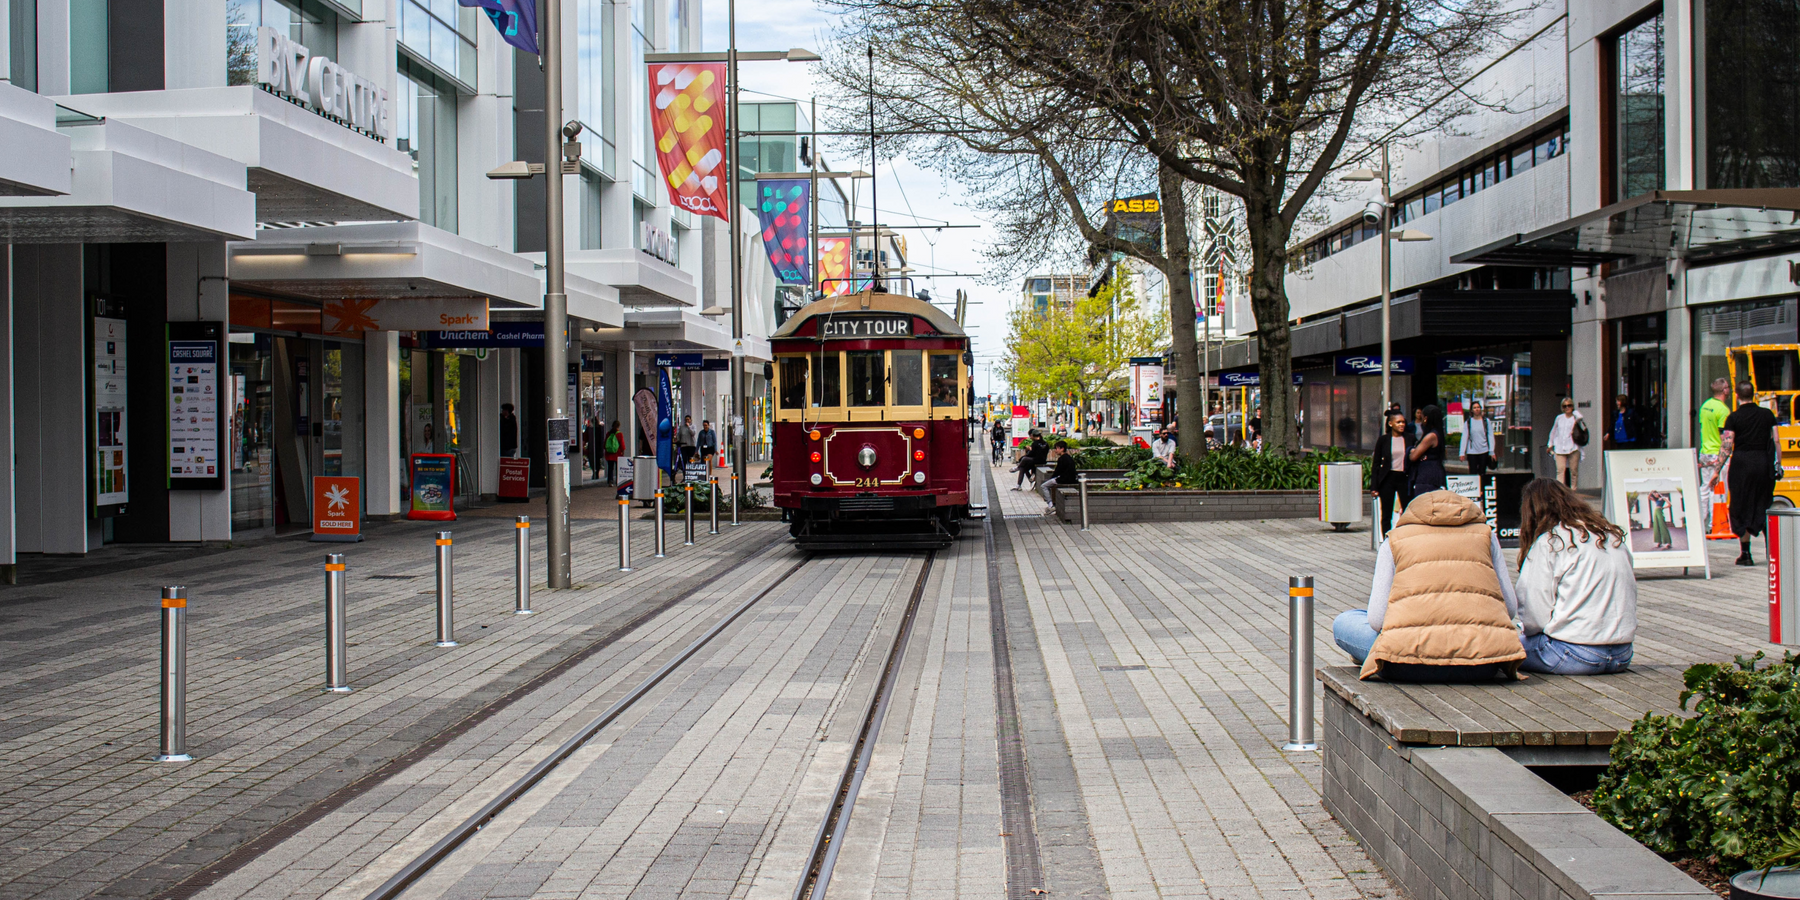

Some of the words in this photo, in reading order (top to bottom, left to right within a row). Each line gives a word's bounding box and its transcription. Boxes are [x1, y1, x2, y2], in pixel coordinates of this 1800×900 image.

[258, 26, 310, 104] BNZ
[309, 56, 389, 140] CENTRE
[1113, 199, 1160, 213] ASB
[440, 313, 474, 326] Spark
[823, 320, 860, 335] CITY
[863, 319, 908, 335] TOUR
[497, 332, 520, 340] Cashel
[173, 350, 192, 358] CASHEL
[193, 350, 213, 358] SQUARE
[656, 358, 672, 366] bnz
[856, 477, 879, 487] 244
